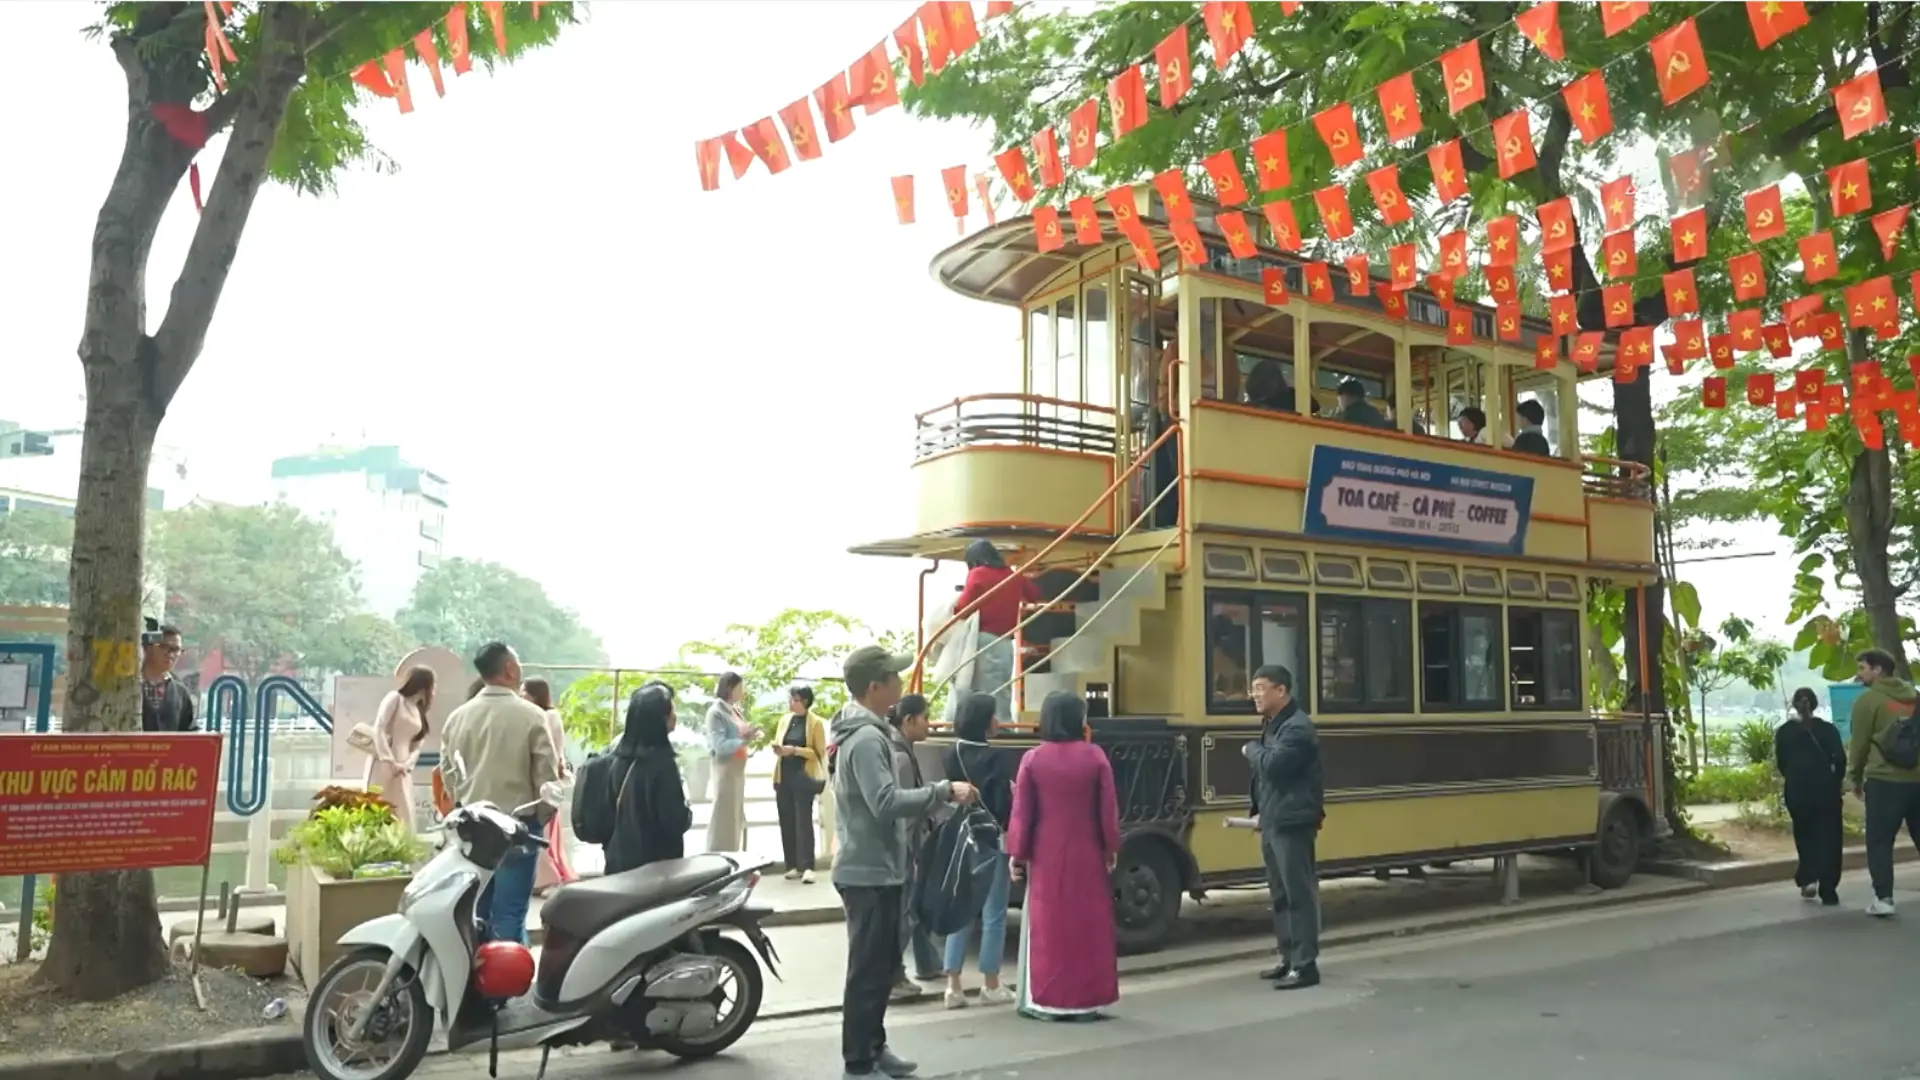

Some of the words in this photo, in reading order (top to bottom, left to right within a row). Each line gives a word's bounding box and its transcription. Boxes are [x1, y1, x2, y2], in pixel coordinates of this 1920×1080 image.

[1337, 486, 1363, 508] TOA
[1412, 495, 1429, 516] CÀ
[1431, 498, 1456, 519] PHÊ
[1466, 504, 1508, 526] COFFEE
[93, 639, 136, 682] 78
[40, 767, 78, 800] VỰC
[84, 760, 127, 792] CẤM
[131, 759, 160, 792] ĐỔ
[162, 763, 198, 791] RÁC
